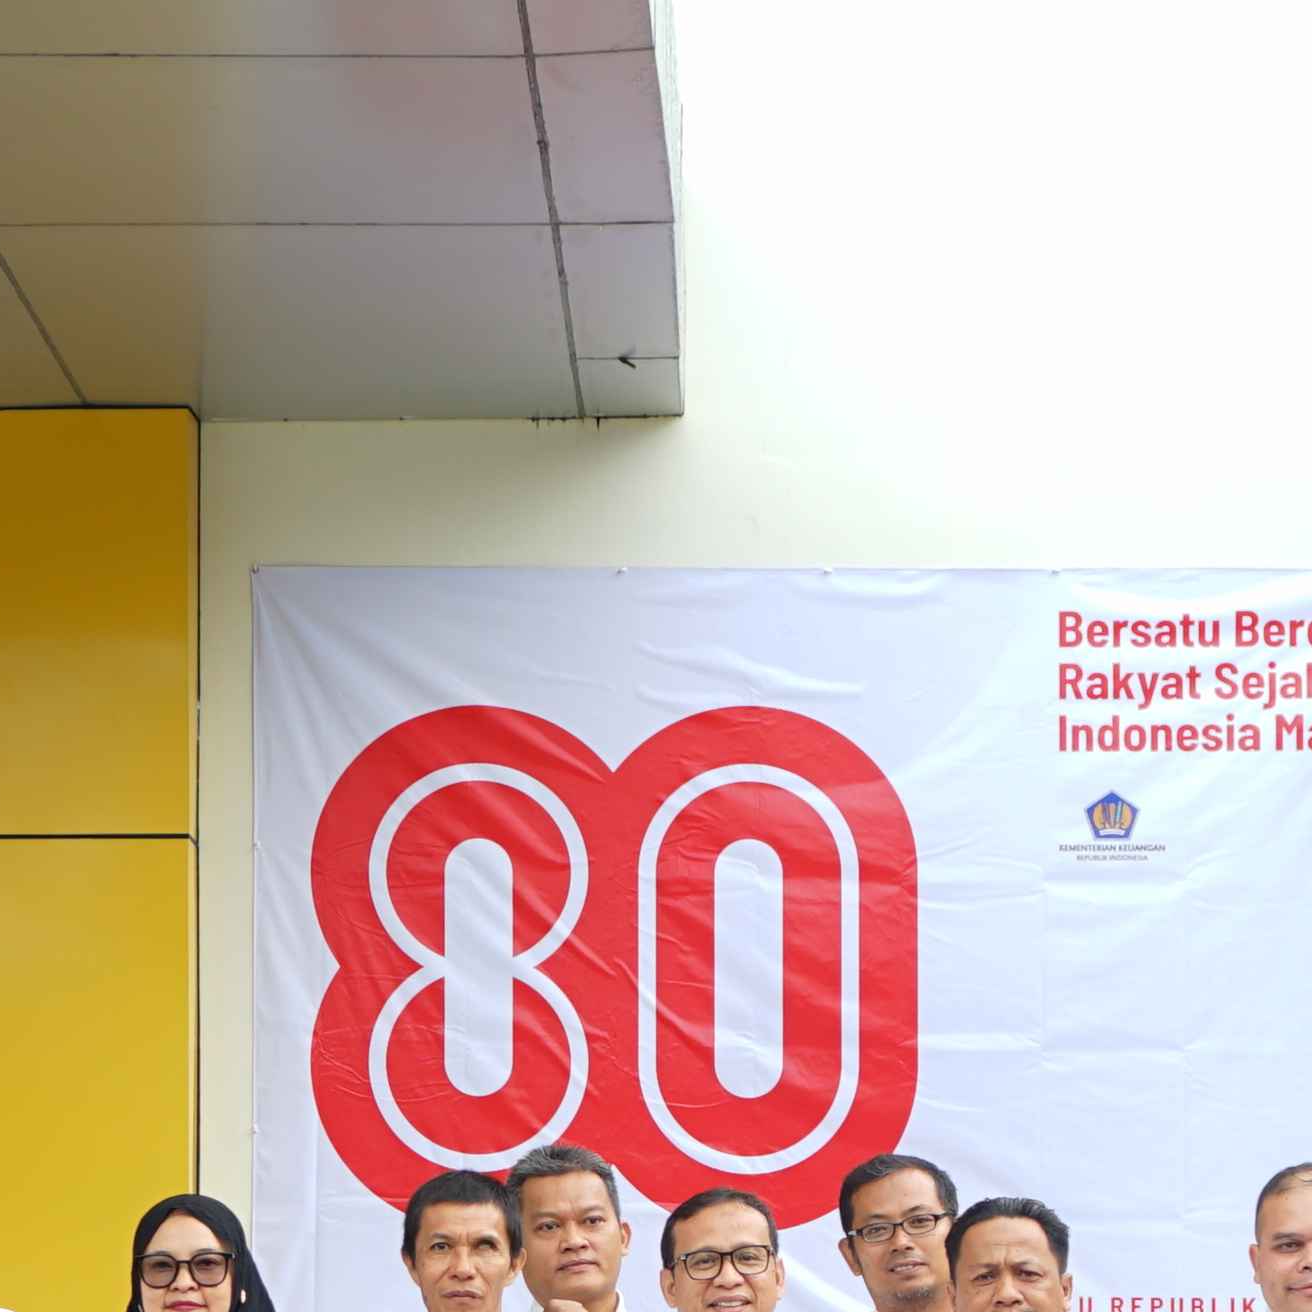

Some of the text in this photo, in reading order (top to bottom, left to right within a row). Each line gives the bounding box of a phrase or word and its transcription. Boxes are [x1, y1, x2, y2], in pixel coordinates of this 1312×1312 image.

[1058, 611, 1221, 648] Bersatu
[1058, 662, 1201, 710] Rakyat
[1058, 714, 1262, 752] Indonesia
[1058, 844, 1166, 852] KEMENTERIAN KEUANGAN
[310, 704, 919, 1231] 80
